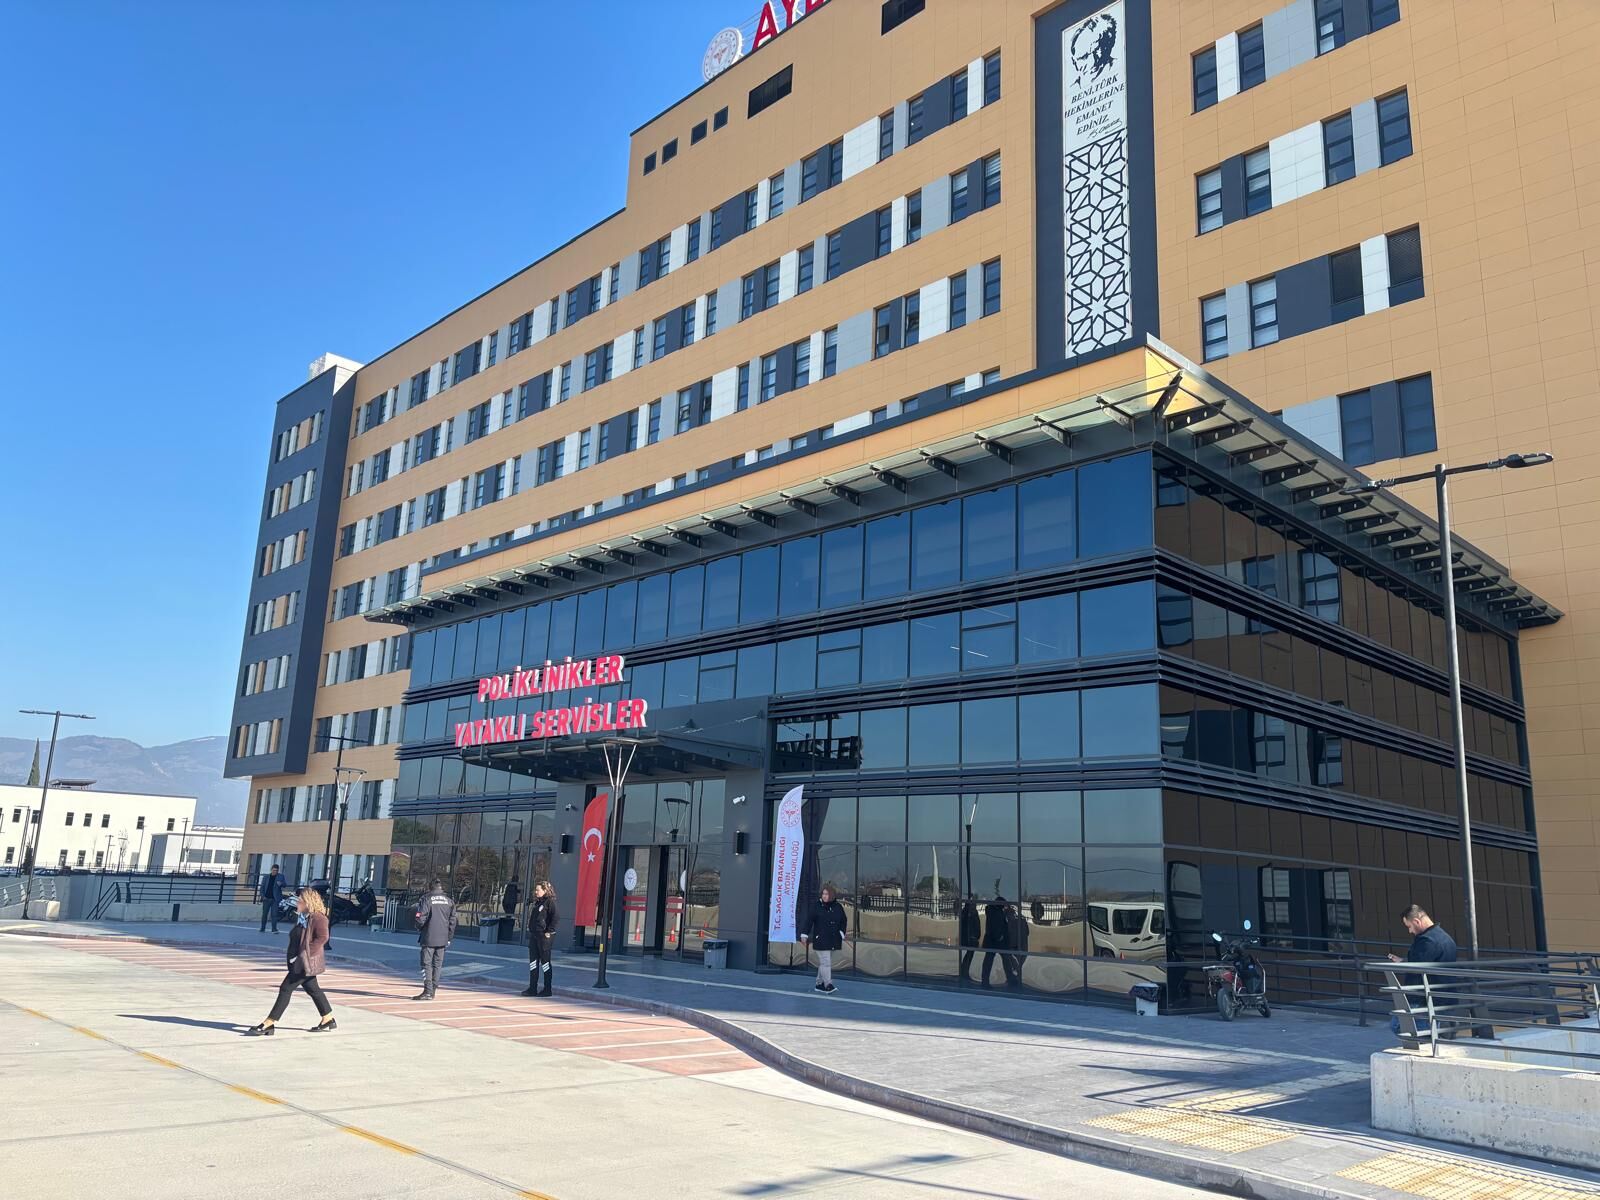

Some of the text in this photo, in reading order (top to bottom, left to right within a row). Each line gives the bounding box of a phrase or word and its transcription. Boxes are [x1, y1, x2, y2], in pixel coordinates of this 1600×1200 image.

[751, 0, 829, 50] AY
[1065, 82, 1125, 118] HEKİMLERİNE
[1075, 100, 1114, 125] EMANET
[1077, 114, 1110, 136] EDİNİZ
[477, 655, 625, 702] POLİKLİNİKLER
[455, 697, 648, 748] YATAKLI SERVİSLER
[777, 836, 786, 882] BAKANLIĞI
[775, 884, 783, 914] SAĞLIK
